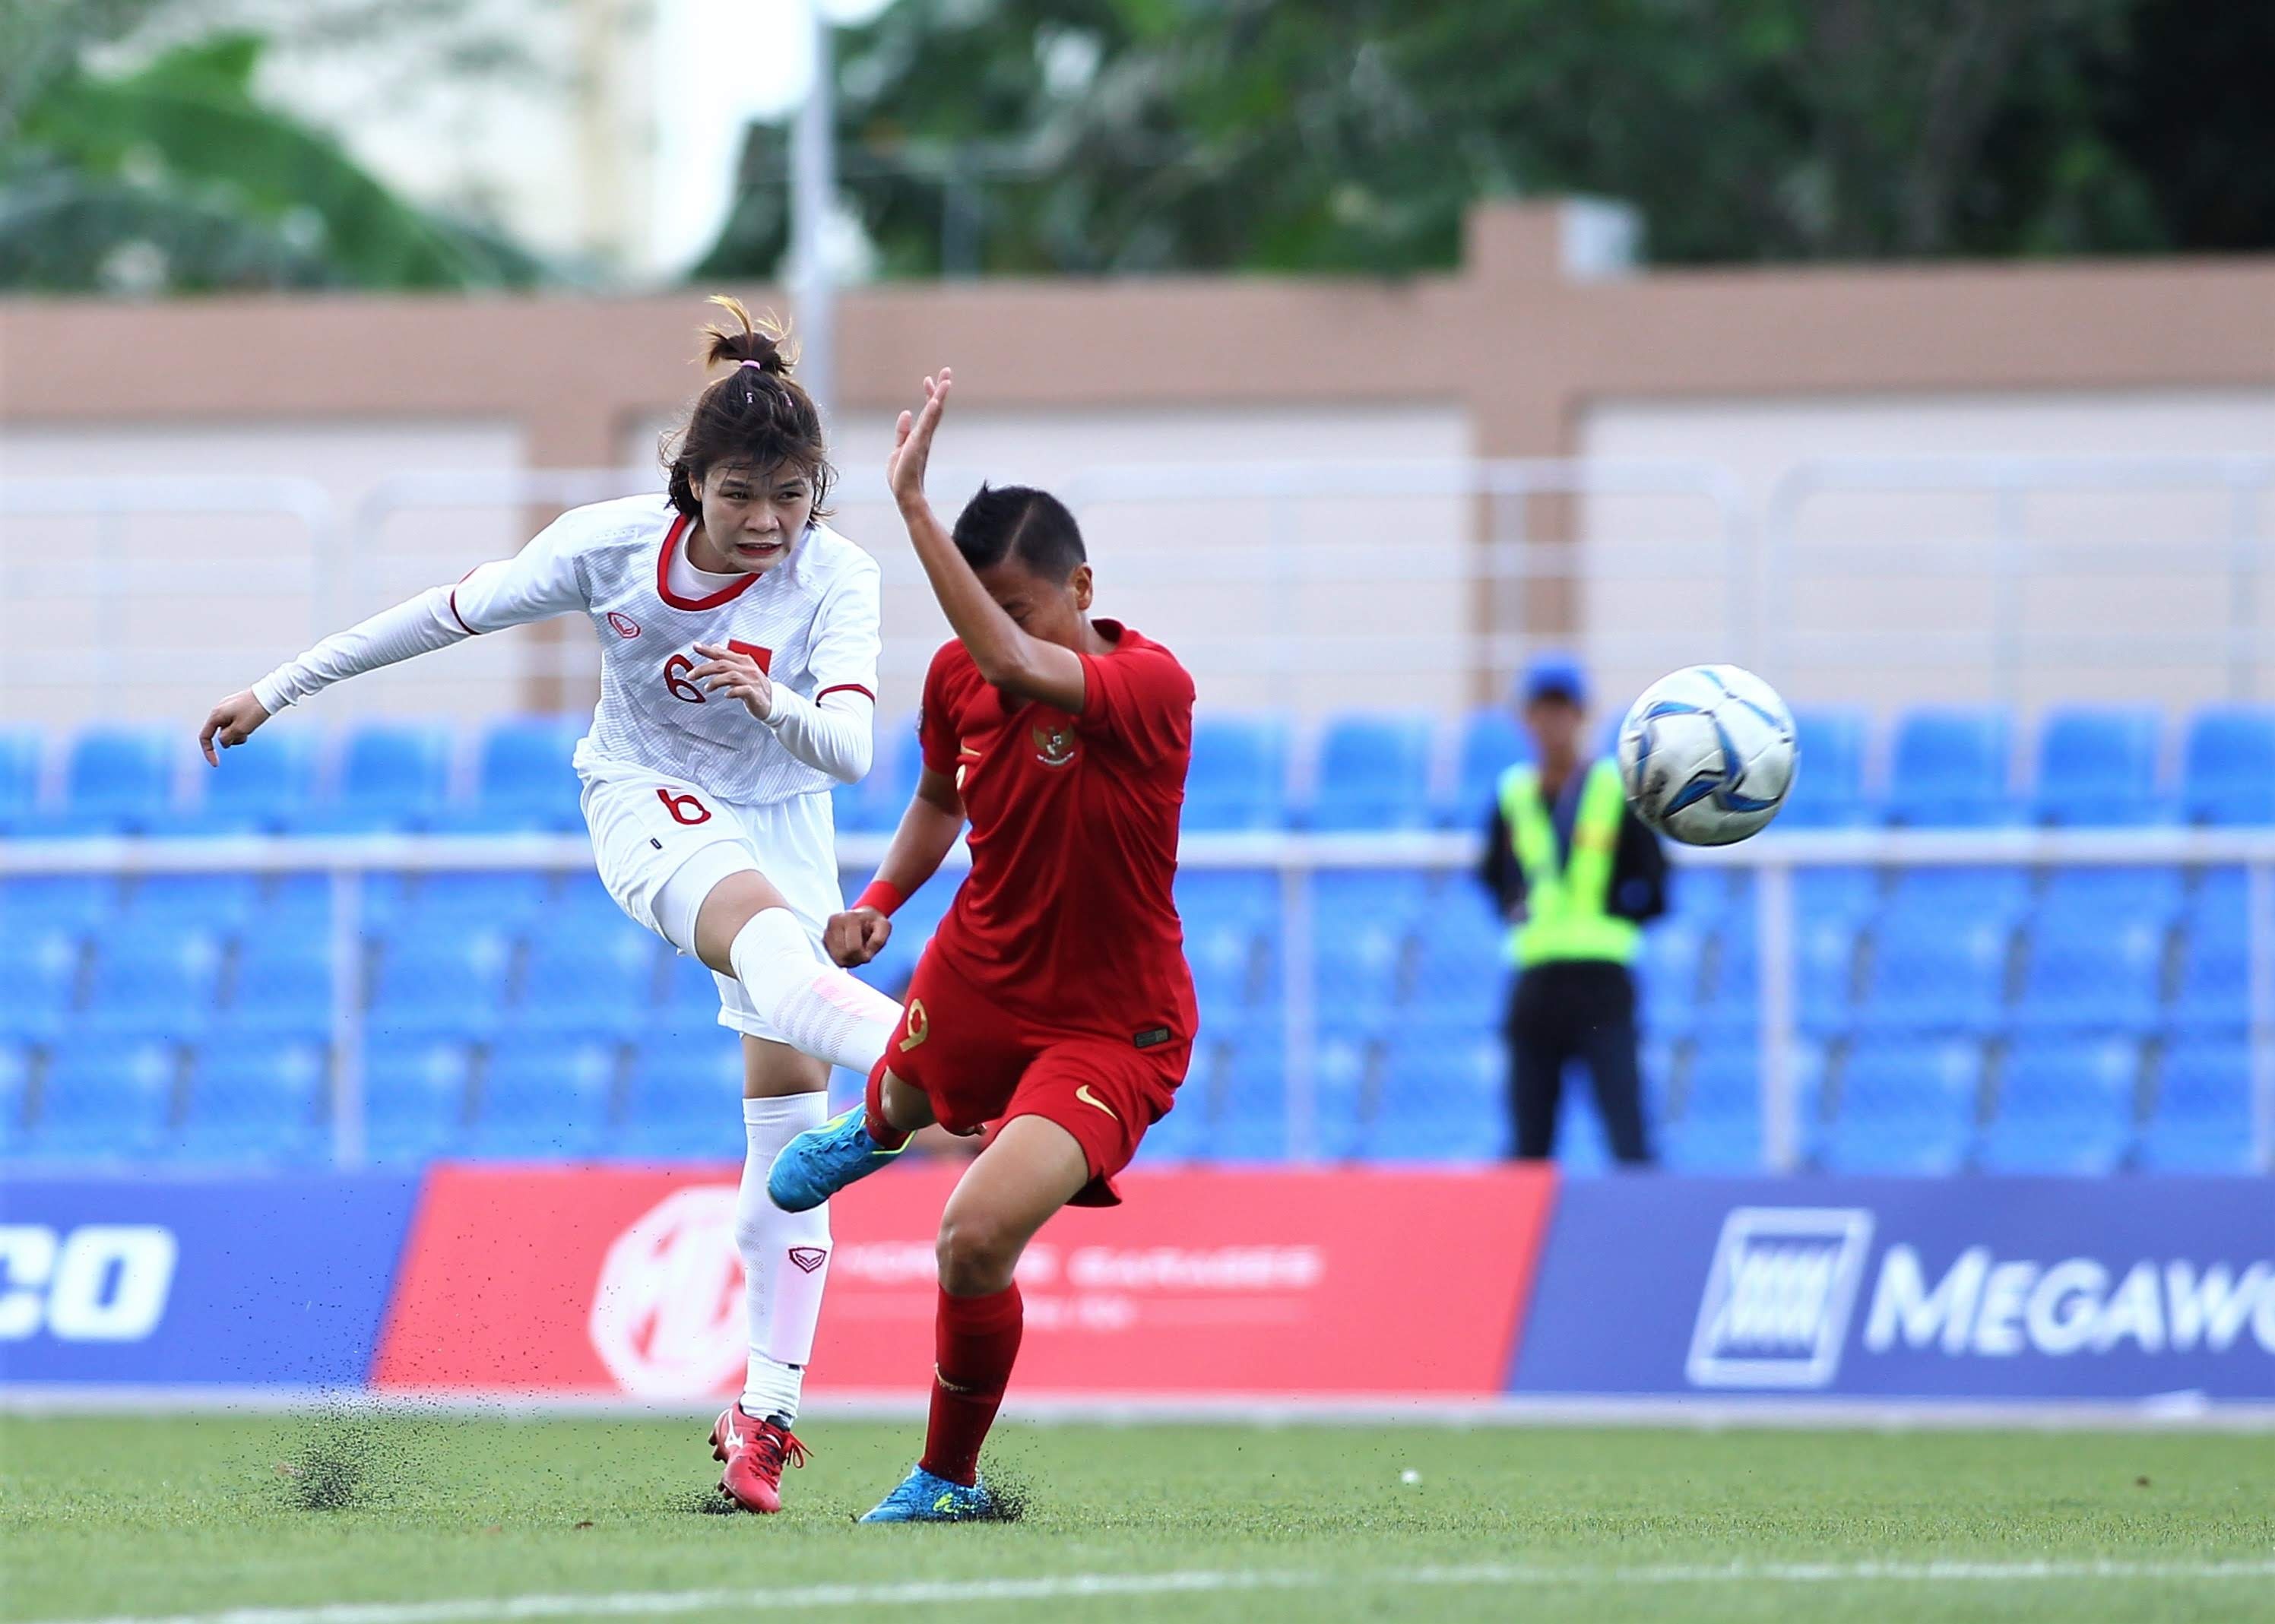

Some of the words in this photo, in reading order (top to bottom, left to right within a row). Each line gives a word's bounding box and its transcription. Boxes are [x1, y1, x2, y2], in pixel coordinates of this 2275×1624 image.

[664, 654, 706, 704] 6
[657, 789, 711, 825] 6
[899, 999, 929, 1053] 9
